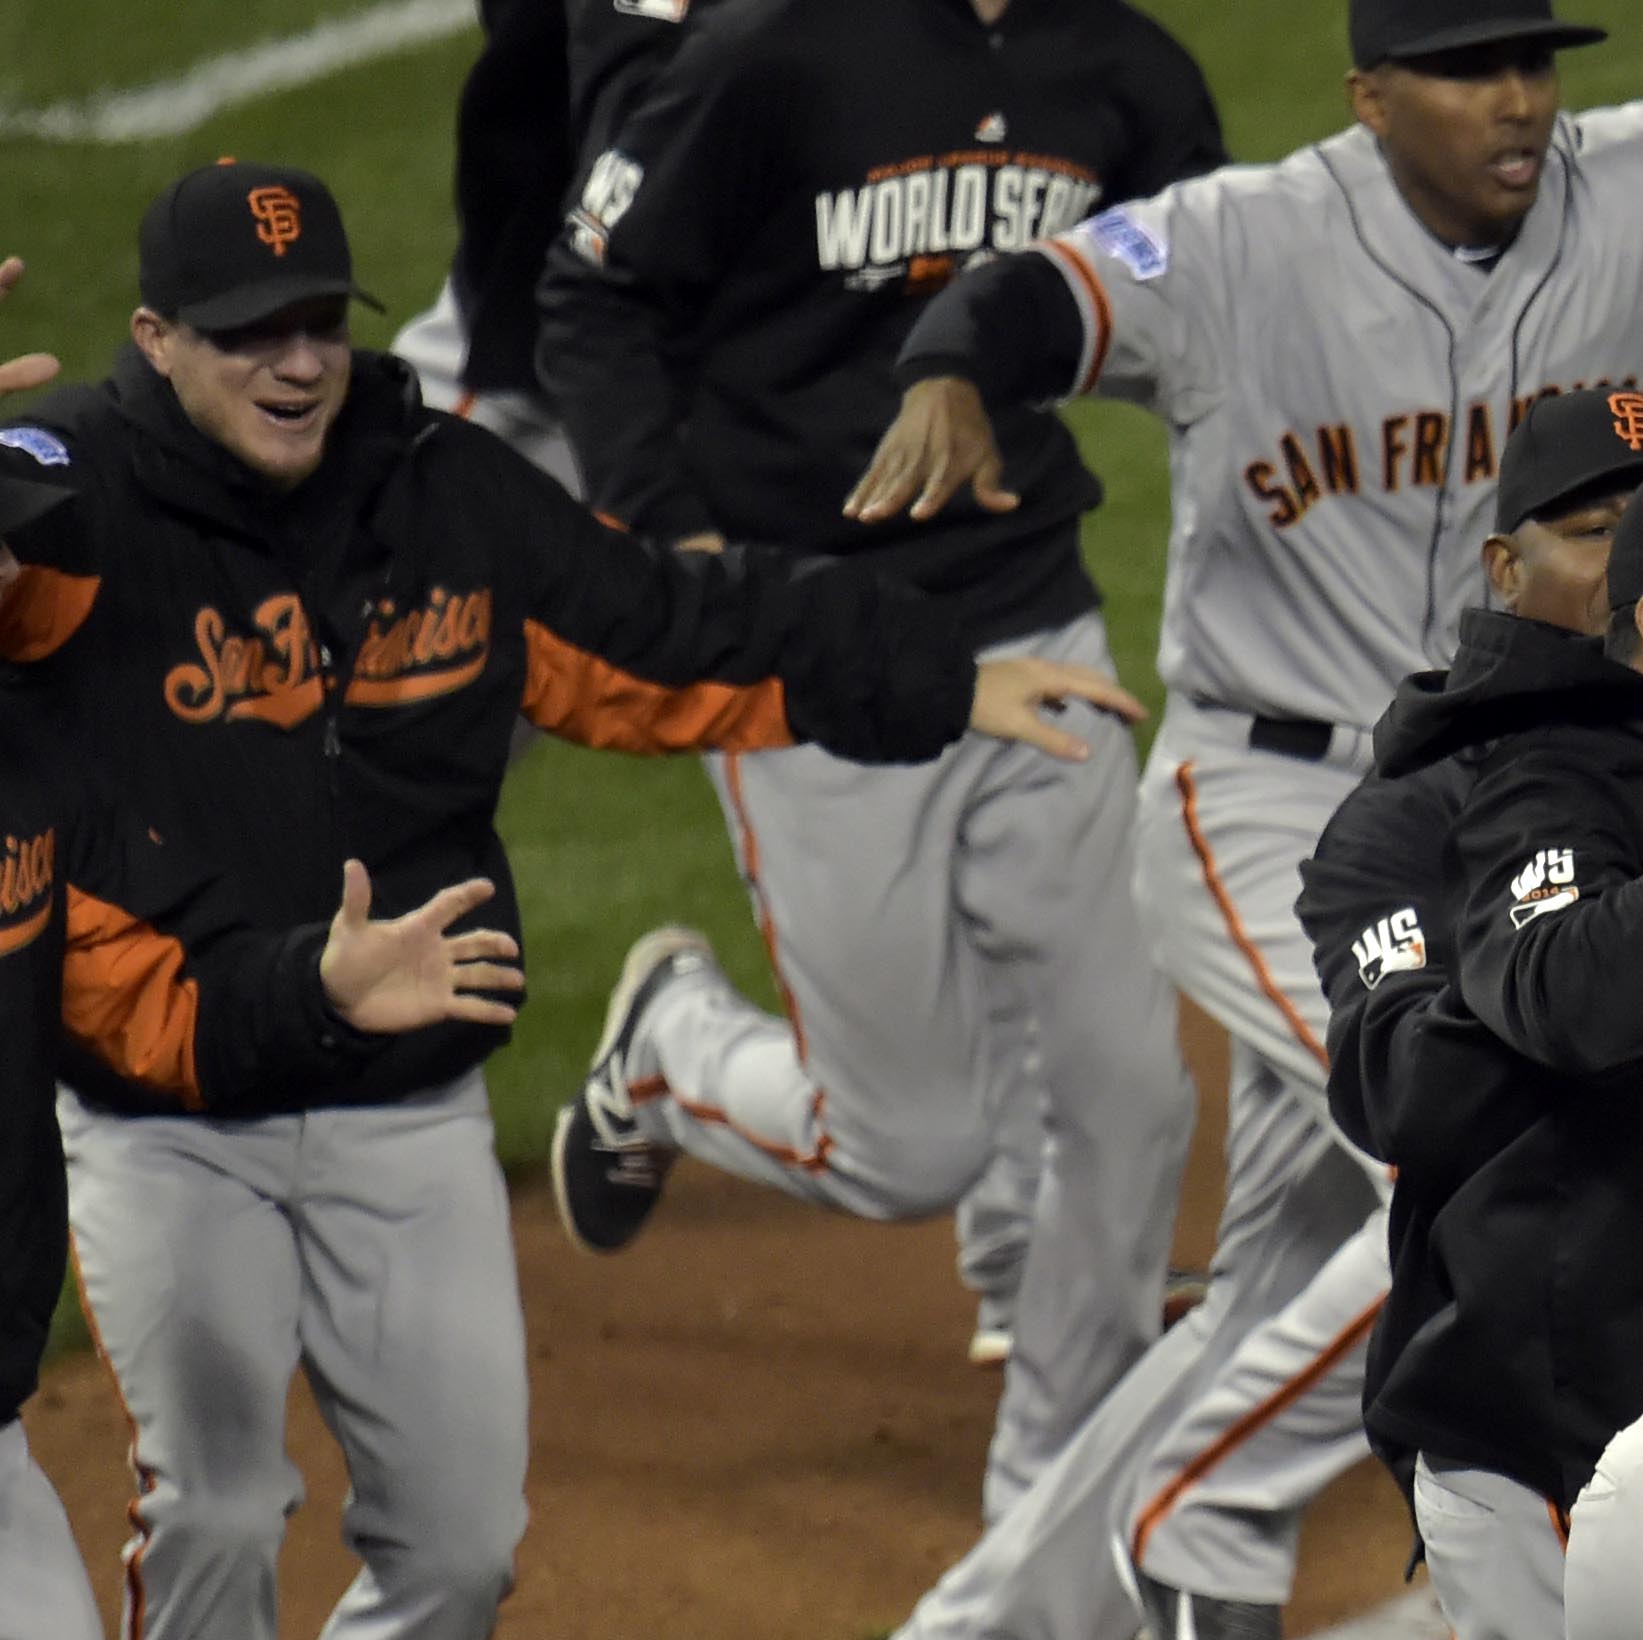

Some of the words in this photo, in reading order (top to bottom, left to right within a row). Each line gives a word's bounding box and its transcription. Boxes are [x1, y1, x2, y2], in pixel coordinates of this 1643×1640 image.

[815, 164, 988, 271] WORLD
[1244, 430, 1359, 529] SAN
[1510, 848, 1575, 901] WS
[1351, 906, 1425, 968] WS
